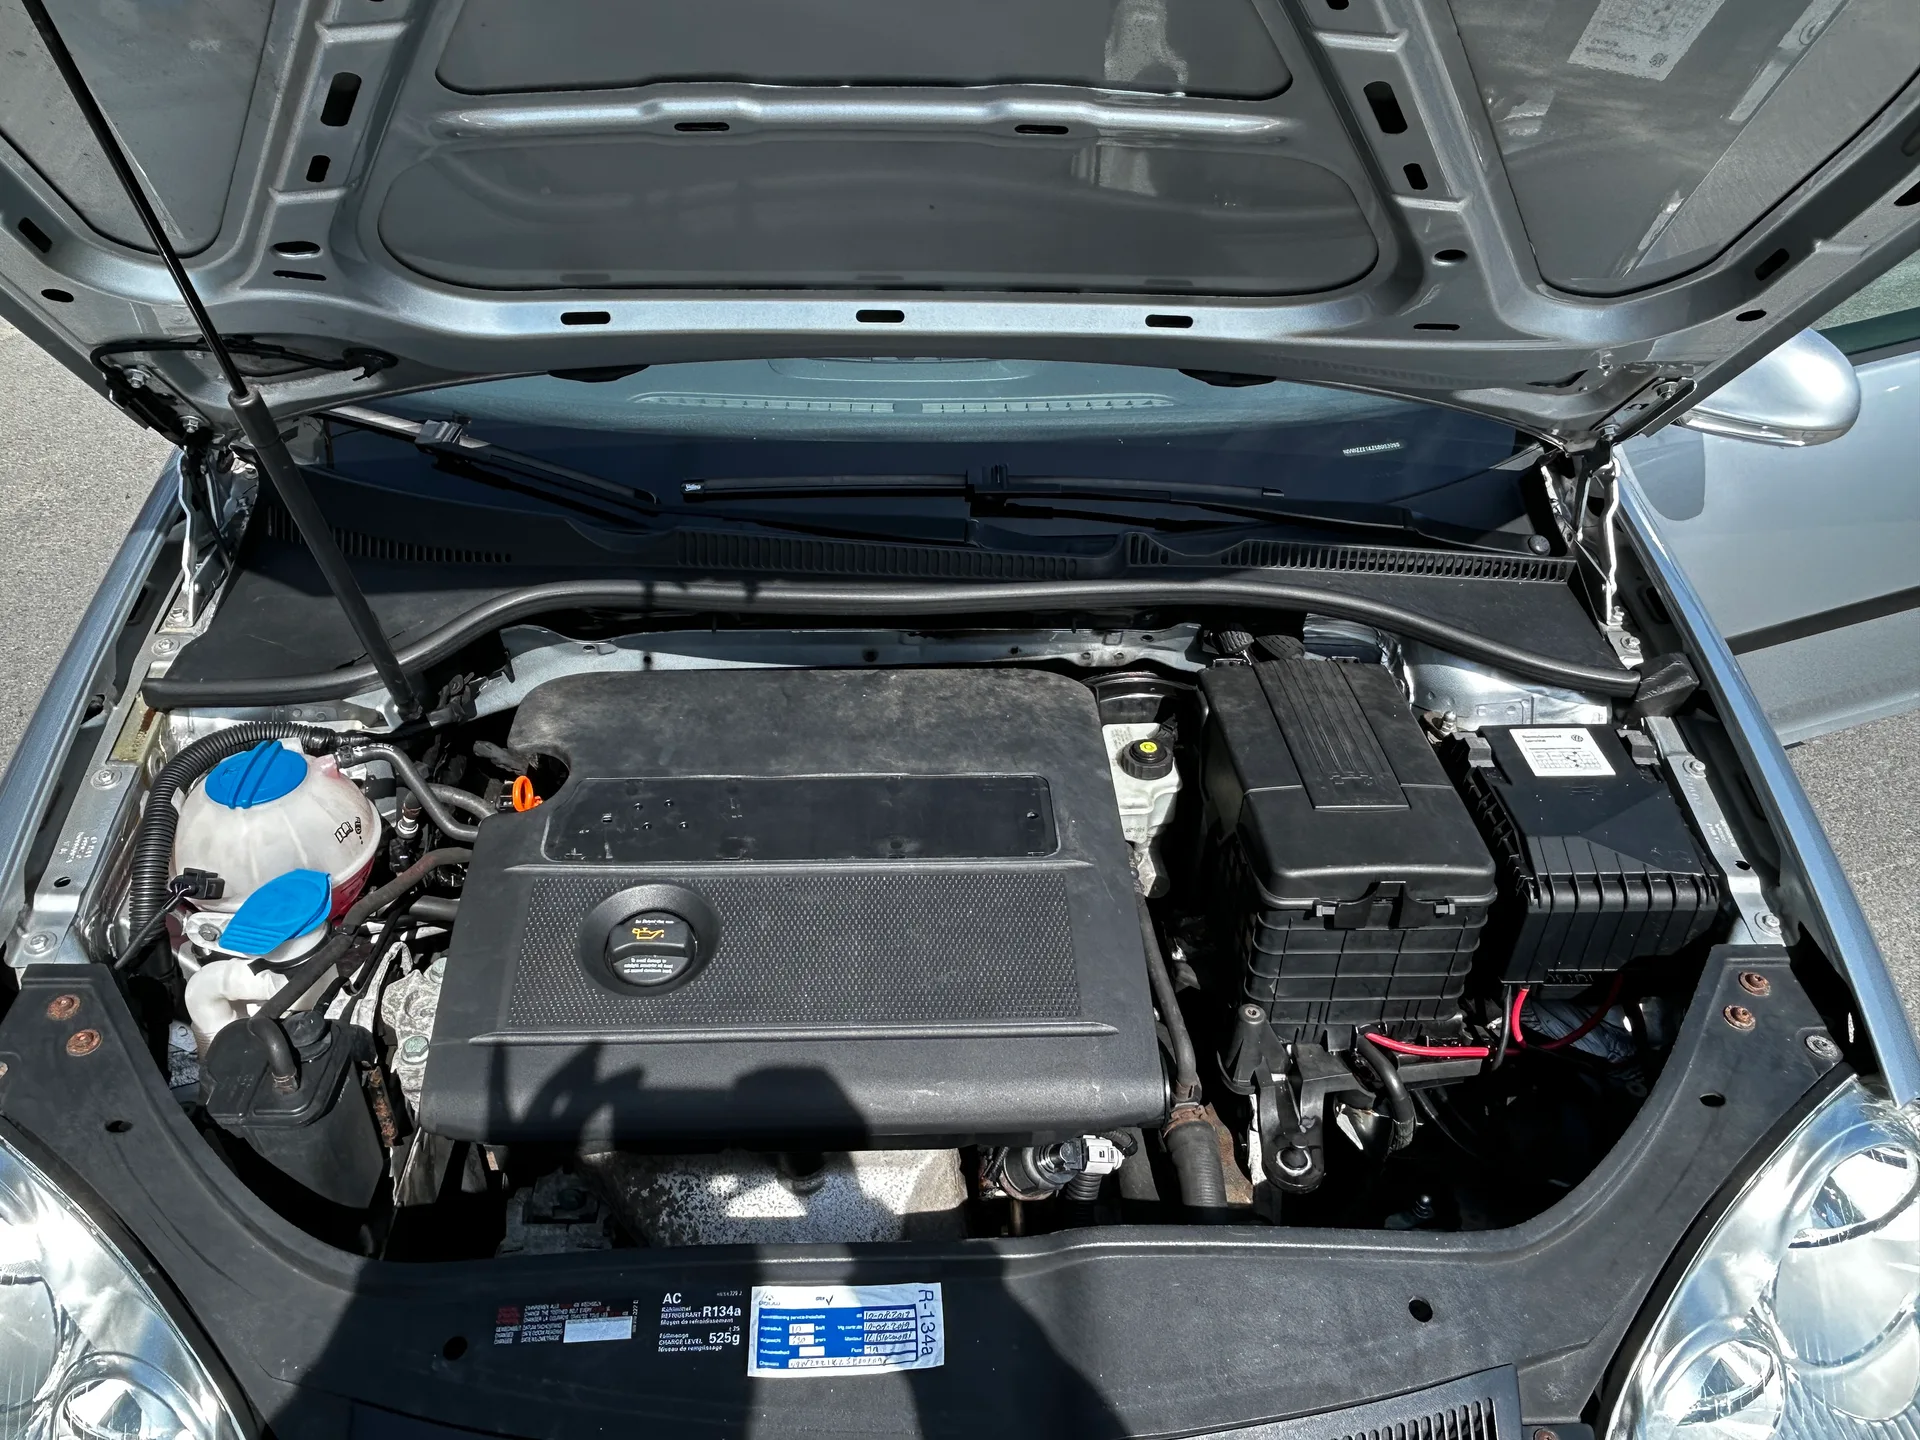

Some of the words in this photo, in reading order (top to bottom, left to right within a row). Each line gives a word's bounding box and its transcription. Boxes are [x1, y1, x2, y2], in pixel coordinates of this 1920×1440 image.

[662, 1292, 682, 1304] AC
[702, 1305, 742, 1318] R134a
[918, 1289, 937, 1356] R-134a
[708, 1332, 740, 1346] 525g
